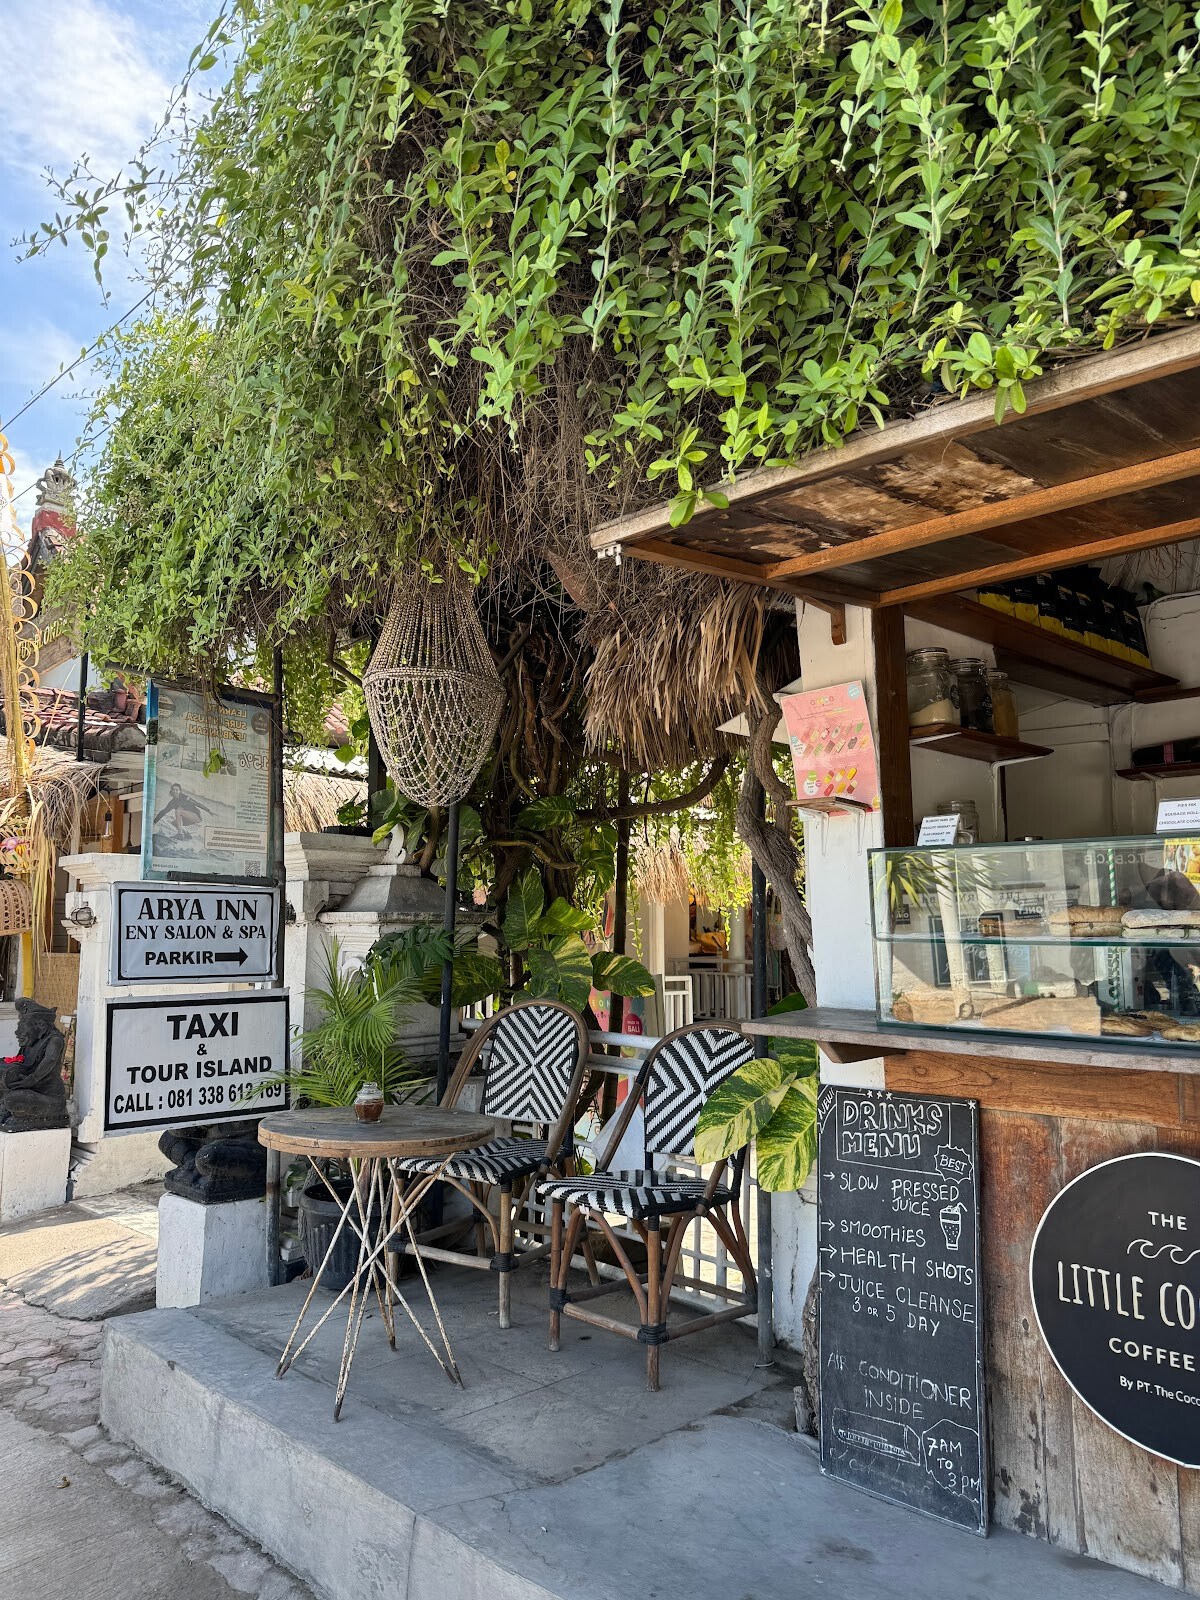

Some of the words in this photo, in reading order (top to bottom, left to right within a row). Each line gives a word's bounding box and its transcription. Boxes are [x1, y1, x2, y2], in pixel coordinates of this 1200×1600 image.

[137, 897, 205, 921] ARYA
[216, 899, 258, 921] INN
[125, 924, 159, 940] ENY
[164, 924, 217, 940] SALON
[222, 925, 234, 939] &
[238, 924, 267, 939] SPA
[145, 950, 214, 966] PARKIR
[166, 1011, 239, 1041] TAXI
[627, 1025, 641, 1033] BALI
[196, 1043, 208, 1056] &
[126, 1062, 189, 1085] TOUR
[196, 1055, 272, 1079] ISLAND
[114, 1092, 153, 1114] CALL
[168, 1088, 193, 1109] 081
[198, 1085, 224, 1106] 338
[817, 1087, 835, 1120] NEW!
[842, 1100, 943, 1136] DRINKS
[842, 1131, 921, 1159] MENU
[939, 1154, 967, 1172] BEST
[839, 1173, 879, 1192] SLOW
[891, 1179, 959, 1202] PRESSED
[1148, 1211, 1187, 1232] THE
[840, 1246, 916, 1273] HEALTH
[926, 1260, 974, 1285] SHOTS
[838, 1273, 885, 1300] JUICE
[896, 1286, 975, 1323] CLEANSE
[1057, 1261, 1145, 1321] LITTLE
[1159, 1281, 1200, 1330] CO
[852, 1297, 861, 1313] 3
[867, 1306, 879, 1317] OR
[885, 1305, 896, 1322] 5
[907, 1312, 940, 1337] DAY
[827, 1351, 848, 1371] AIR
[1108, 1337, 1196, 1373] COFFEE
[1119, 1375, 1134, 1391] By
[1136, 1381, 1153, 1395] PT.
[1154, 1384, 1174, 1401] The
[927, 1437, 963, 1457] 7AM
[937, 1457, 953, 1470] TO
[948, 1472, 957, 1487] 3
